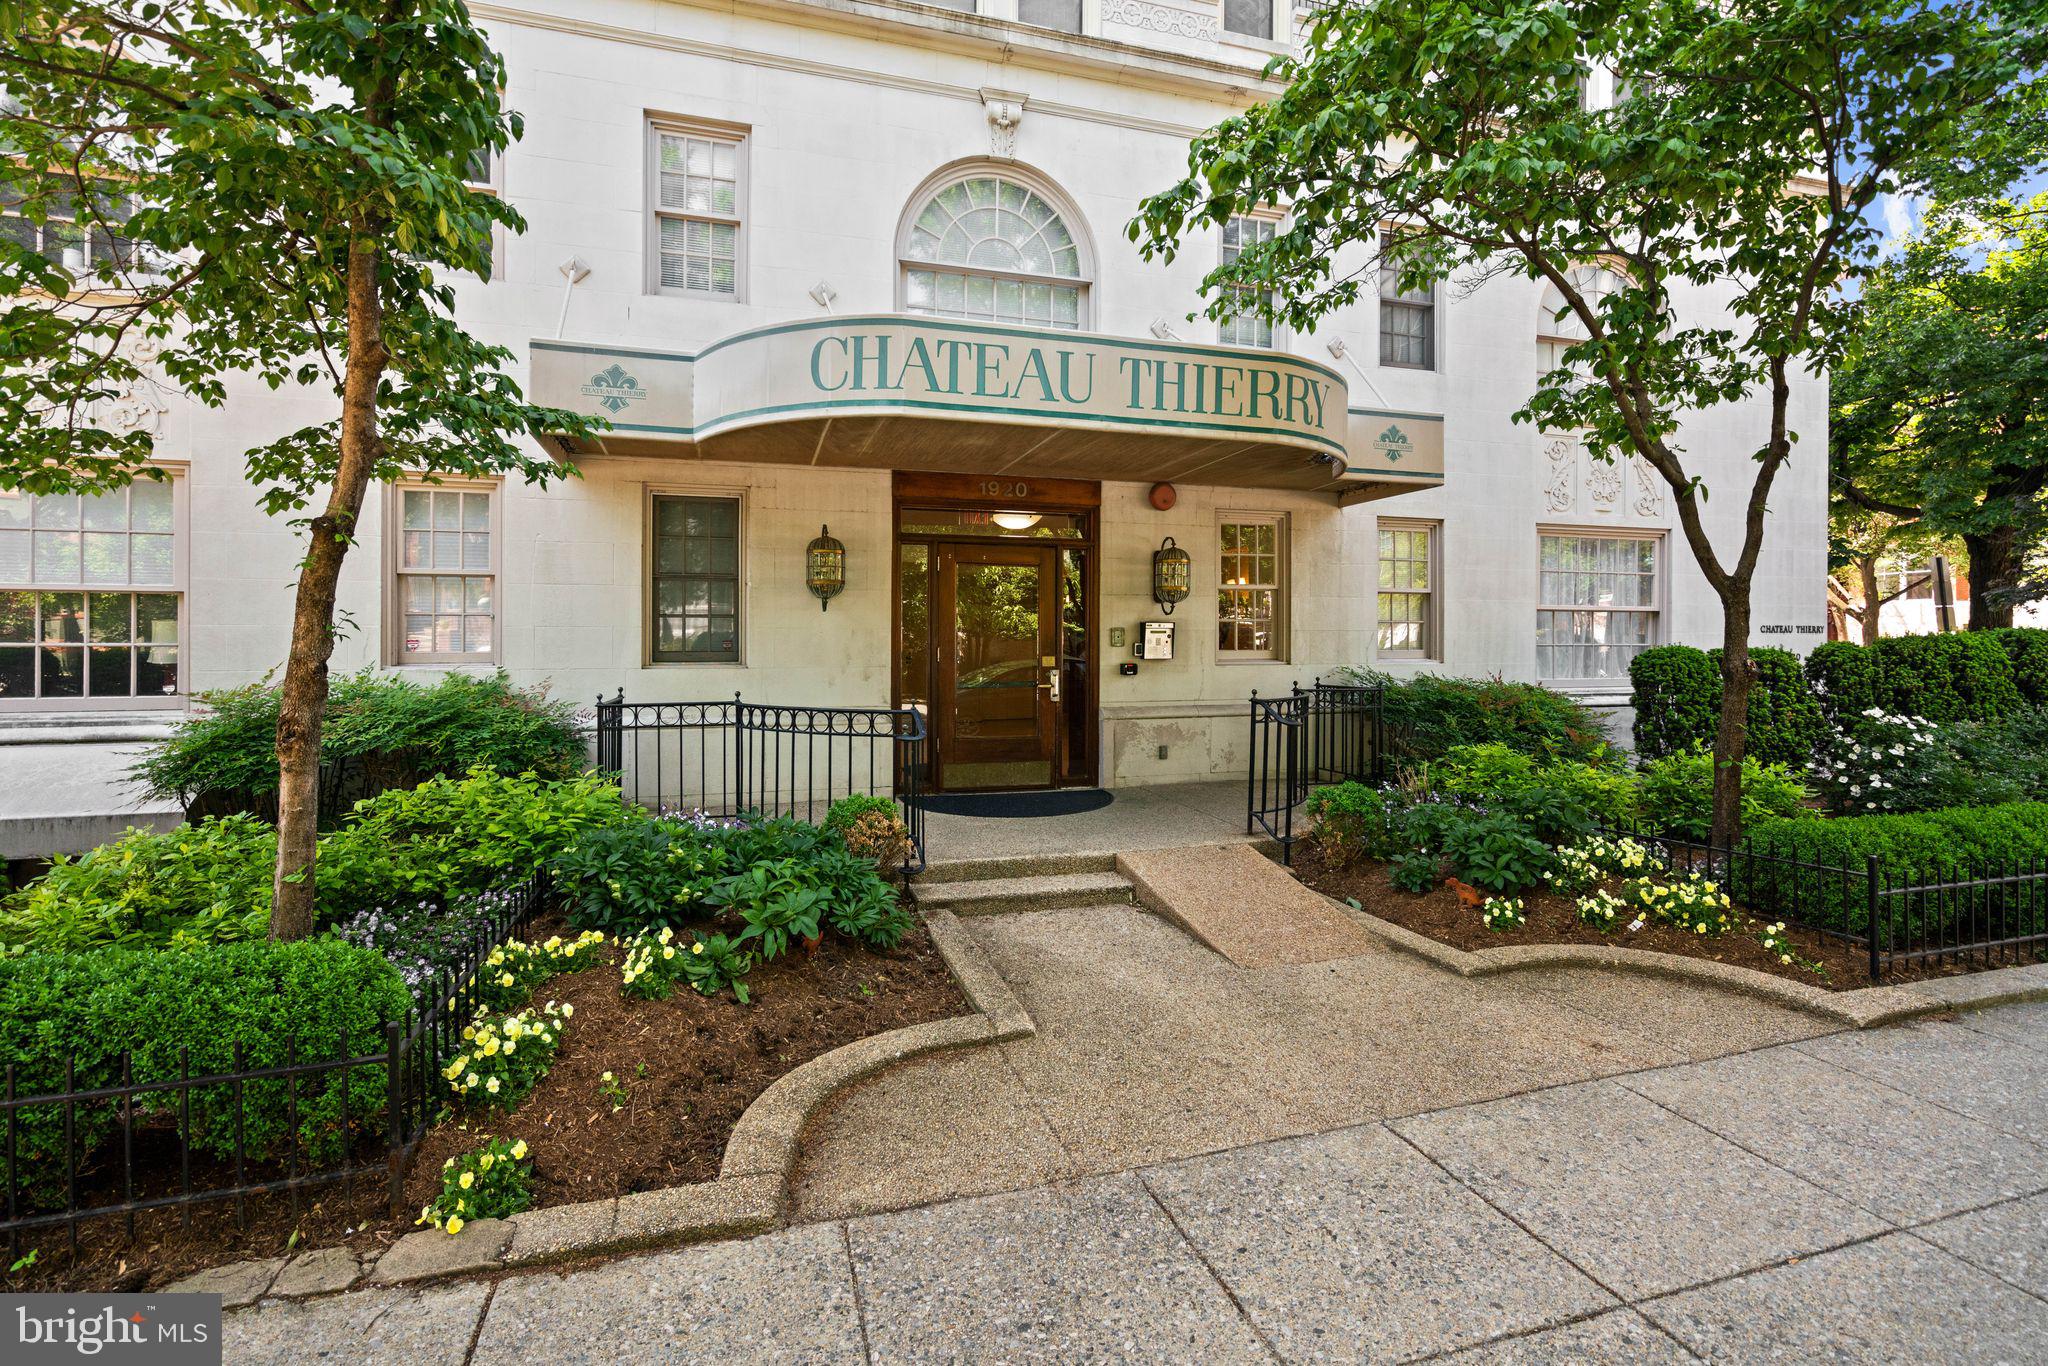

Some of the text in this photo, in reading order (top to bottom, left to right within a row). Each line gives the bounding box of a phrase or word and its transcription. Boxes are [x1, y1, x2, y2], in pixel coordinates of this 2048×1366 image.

[810, 335, 1331, 430] CHATEAU THIERRY
[580, 386, 648, 398] CHATEAU THIERRY
[978, 480, 1028, 498] 1920
[1760, 624, 1825, 635] CHATEAU THIERRY
